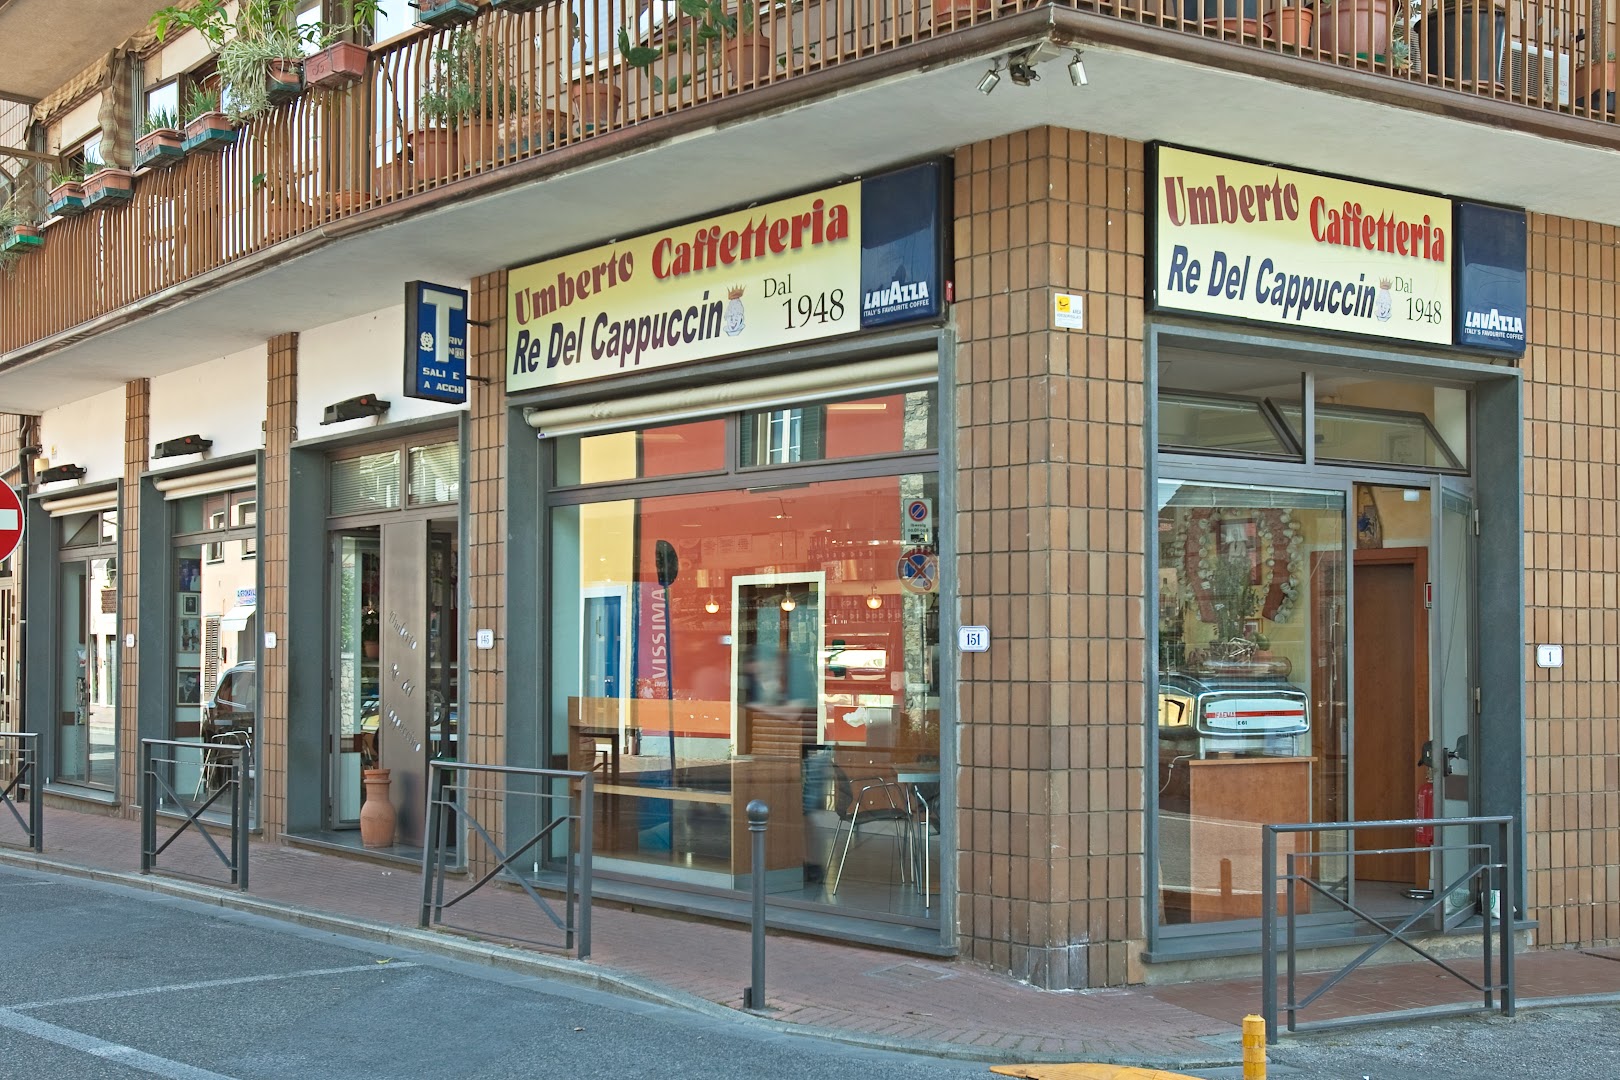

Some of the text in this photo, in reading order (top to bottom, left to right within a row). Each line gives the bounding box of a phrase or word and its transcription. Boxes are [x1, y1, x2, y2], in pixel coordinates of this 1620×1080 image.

[1164, 173, 1445, 262] Umberto Caffetteria
[515, 198, 849, 326] Umberto Caffetteria
[1167, 244, 1201, 294] Re
[1207, 250, 1250, 301] Del
[763, 273, 793, 299] Dal
[864, 281, 929, 310] LAVAZZA
[1395, 276, 1413, 295] Dal
[782, 288, 845, 331] 1948
[863, 299, 929, 317] ITALY'S FAVOURITE COFFEE
[1405, 297, 1442, 325] 1948
[1465, 308, 1523, 333] LAVAZZA
[423, 289, 463, 363] T
[1481, 330, 1506, 338] FAVOURITE
[512, 329, 541, 376] Re
[546, 311, 585, 369] Del
[422, 367, 460, 380] SALI E
[966, 633, 980, 646] 151
